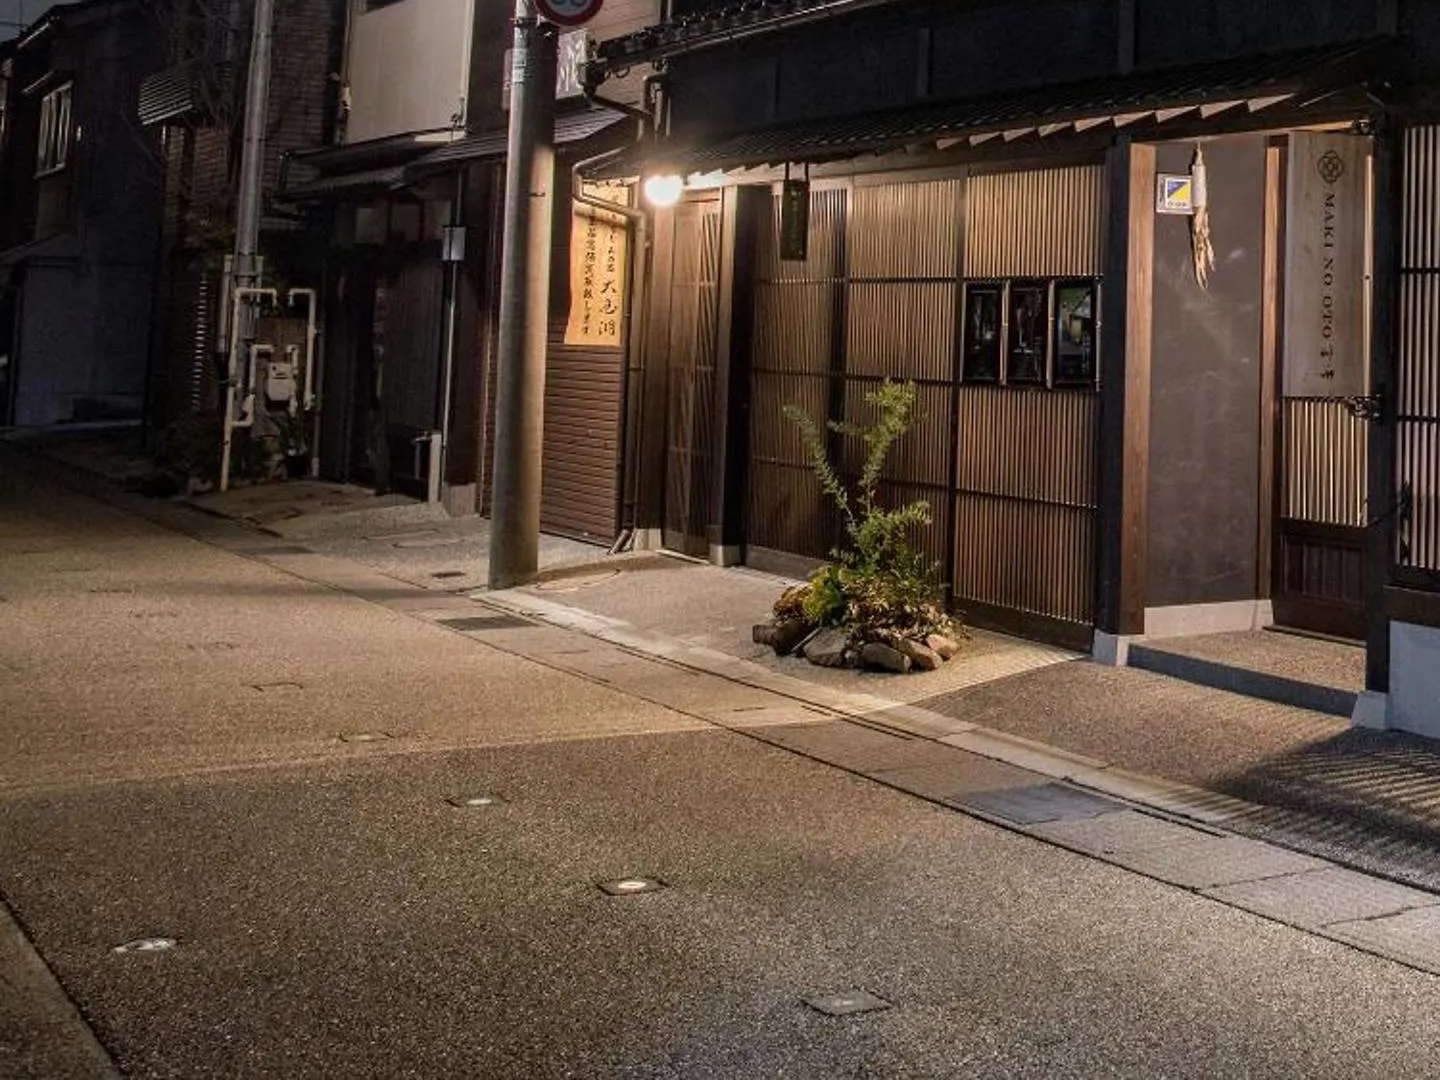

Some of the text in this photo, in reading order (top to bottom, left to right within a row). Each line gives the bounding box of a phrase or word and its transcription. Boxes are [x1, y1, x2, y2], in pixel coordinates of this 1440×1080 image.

[1323, 192, 1335, 248] MAKI
[1322, 258, 1334, 286] NO
[1321, 296, 1334, 339] OTO
